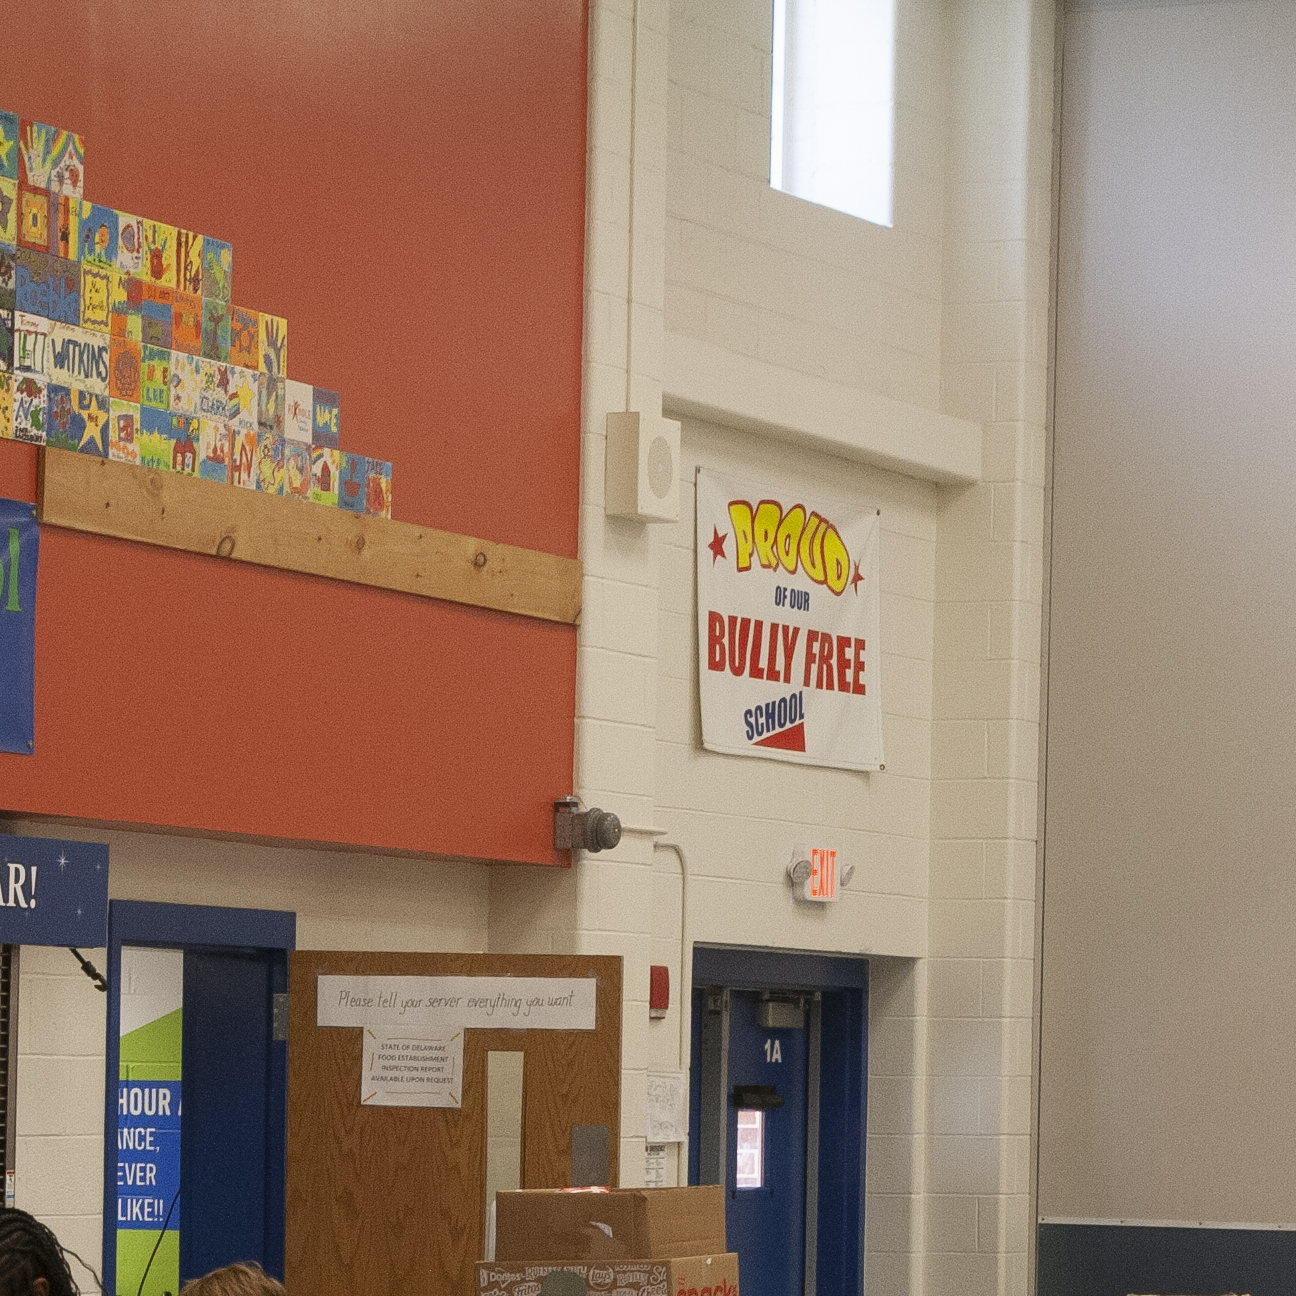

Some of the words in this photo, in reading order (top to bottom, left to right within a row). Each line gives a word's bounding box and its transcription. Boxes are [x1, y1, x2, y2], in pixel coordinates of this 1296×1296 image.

[728, 499, 851, 597] PROUD
[774, 585, 787, 608] OF
[789, 589, 810, 612] OUR
[707, 610, 800, 684] BULLY
[803, 628, 866, 696] FREE
[743, 690, 805, 741] SCHOOL
[810, 848, 837, 898] EXIT
[338, 989, 373, 1008] Please
[377, 991, 398, 1008] tell
[425, 996, 463, 1008] server
[467, 992, 522, 1017] everything
[523, 996, 546, 1017] you
[547, 990, 575, 1008] want
[378, 1054, 397, 1062] FOOD
[381, 1043, 400, 1051] STATE
[764, 1039, 782, 1063] 1A
[117, 1198, 164, 1222] LIKE!!
